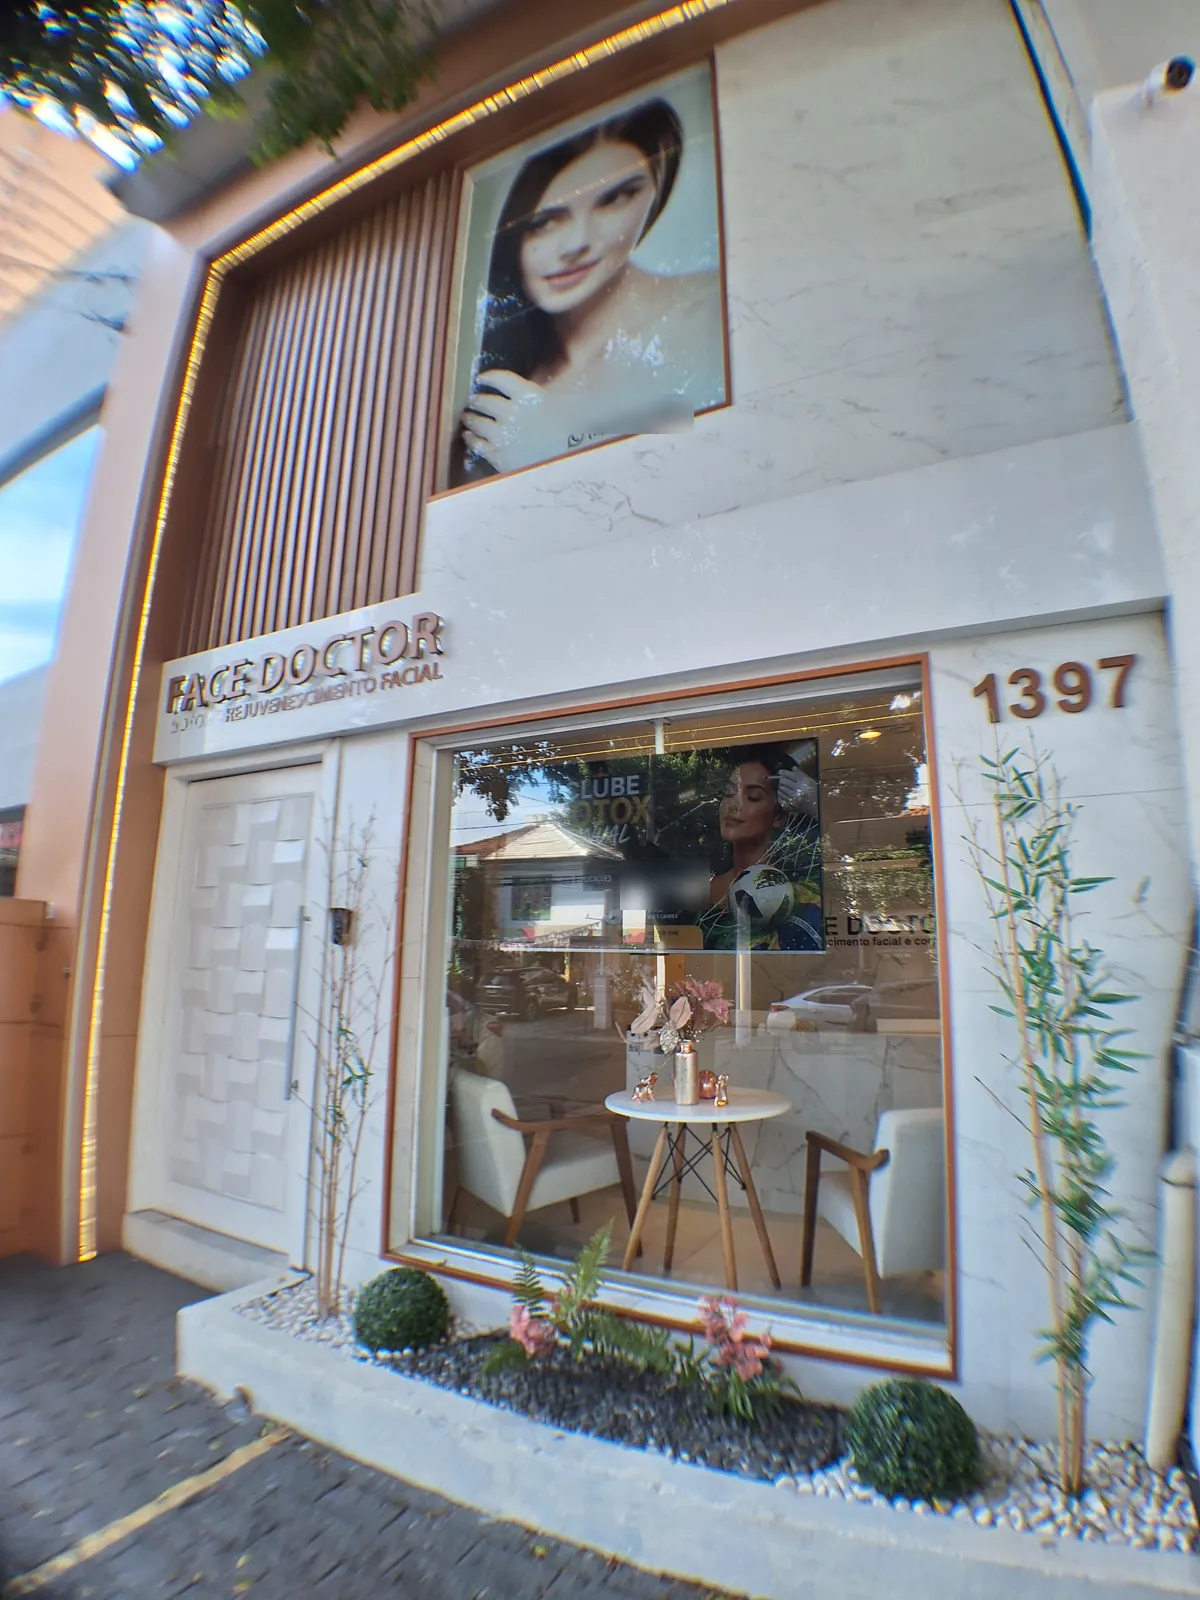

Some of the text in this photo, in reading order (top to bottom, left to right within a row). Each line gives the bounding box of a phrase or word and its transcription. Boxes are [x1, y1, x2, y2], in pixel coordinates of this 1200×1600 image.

[166, 611, 444, 714] FACE DOCTOR
[380, 662, 444, 691] FACIAL
[972, 653, 1136, 724] 1397
[569, 775, 640, 800] CLUBE
[568, 795, 652, 829] OTOX
[873, 936, 902, 946] facial
